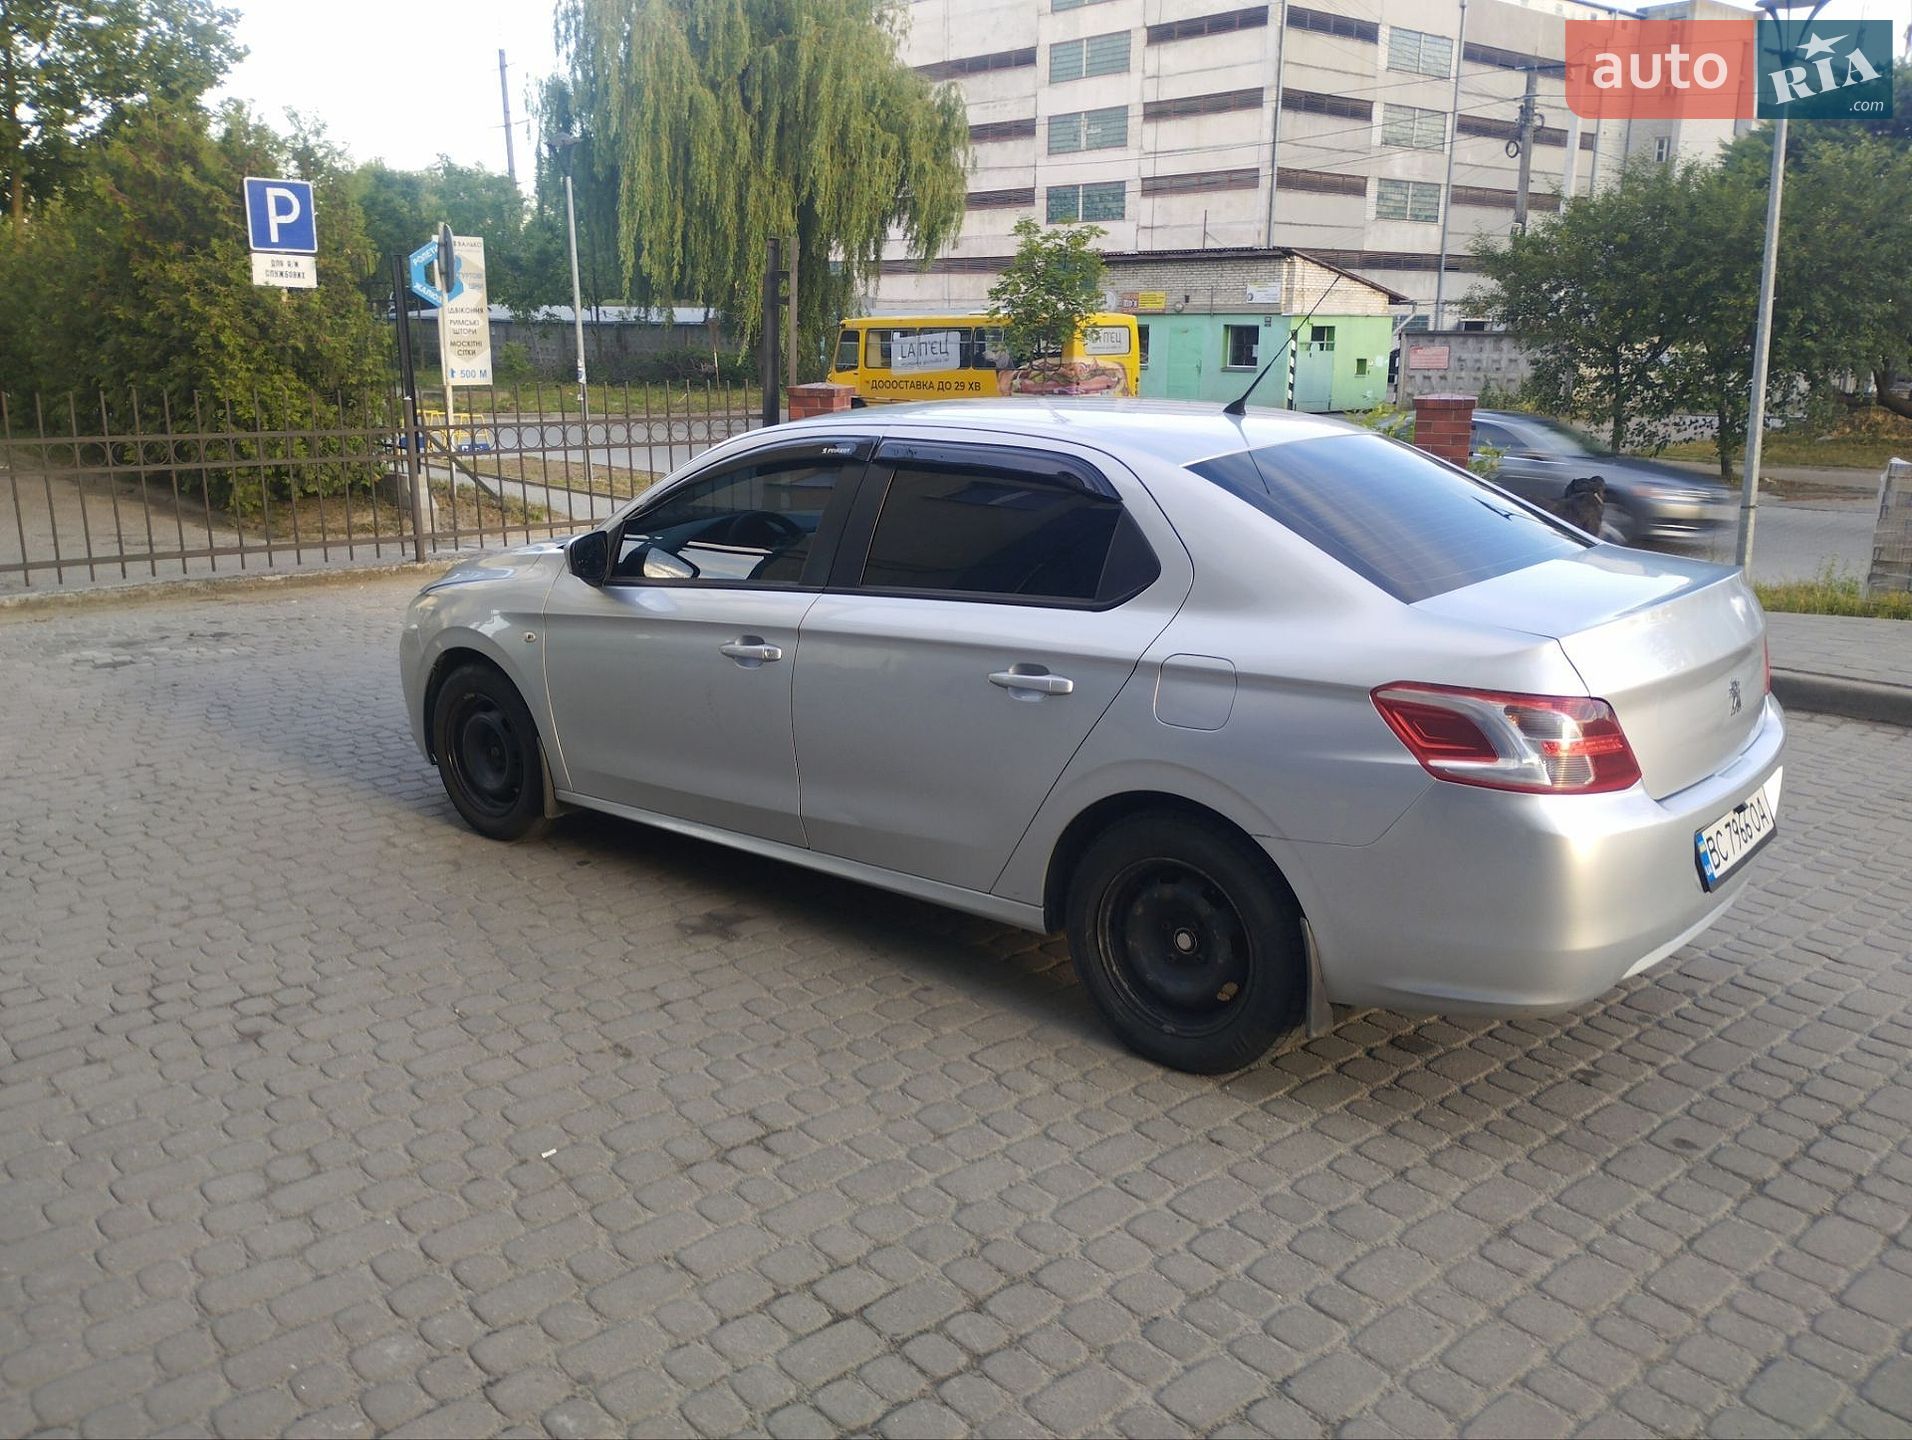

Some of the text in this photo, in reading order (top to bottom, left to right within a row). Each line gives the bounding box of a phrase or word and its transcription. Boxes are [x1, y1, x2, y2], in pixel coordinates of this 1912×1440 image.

[266, 187, 300, 243] P
[460, 369, 476, 379] 500
[937, 381, 952, 392] ДО
[954, 381, 965, 391] 29
[1706, 830, 1728, 870] BC
[1749, 797, 1770, 832] OA
